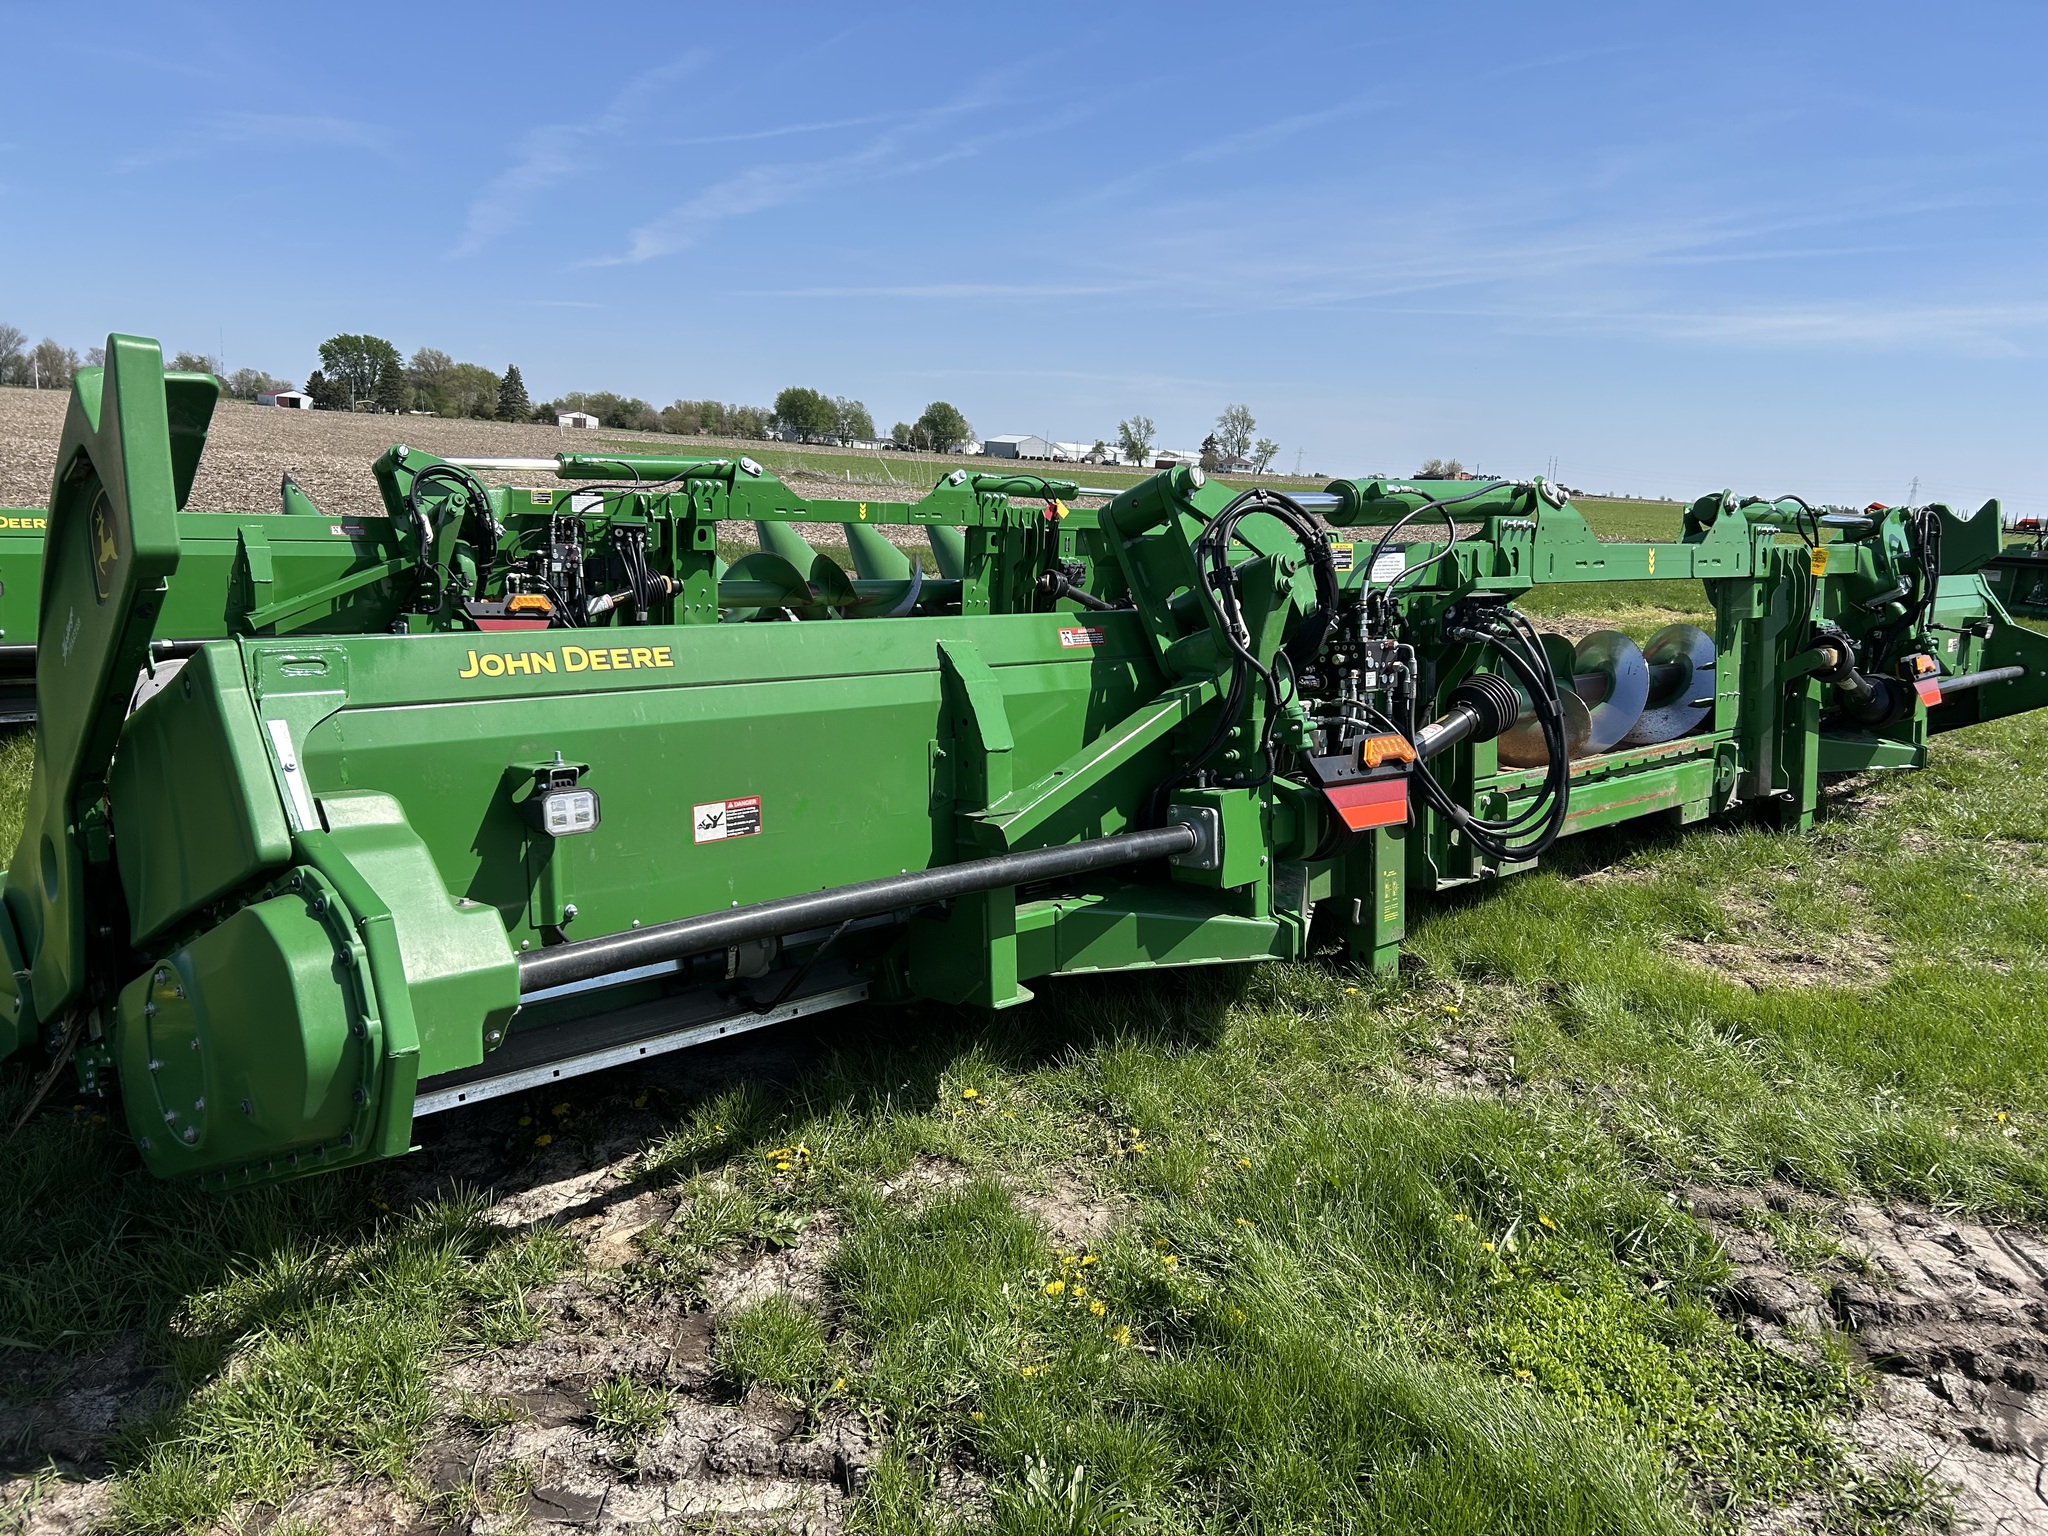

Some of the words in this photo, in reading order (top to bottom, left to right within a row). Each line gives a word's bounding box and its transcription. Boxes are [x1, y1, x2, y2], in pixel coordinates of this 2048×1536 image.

[0, 516, 47, 529] DEER
[459, 649, 558, 678] JOHN
[561, 645, 674, 673] DEERE
[733, 798, 757, 807] DANGER
